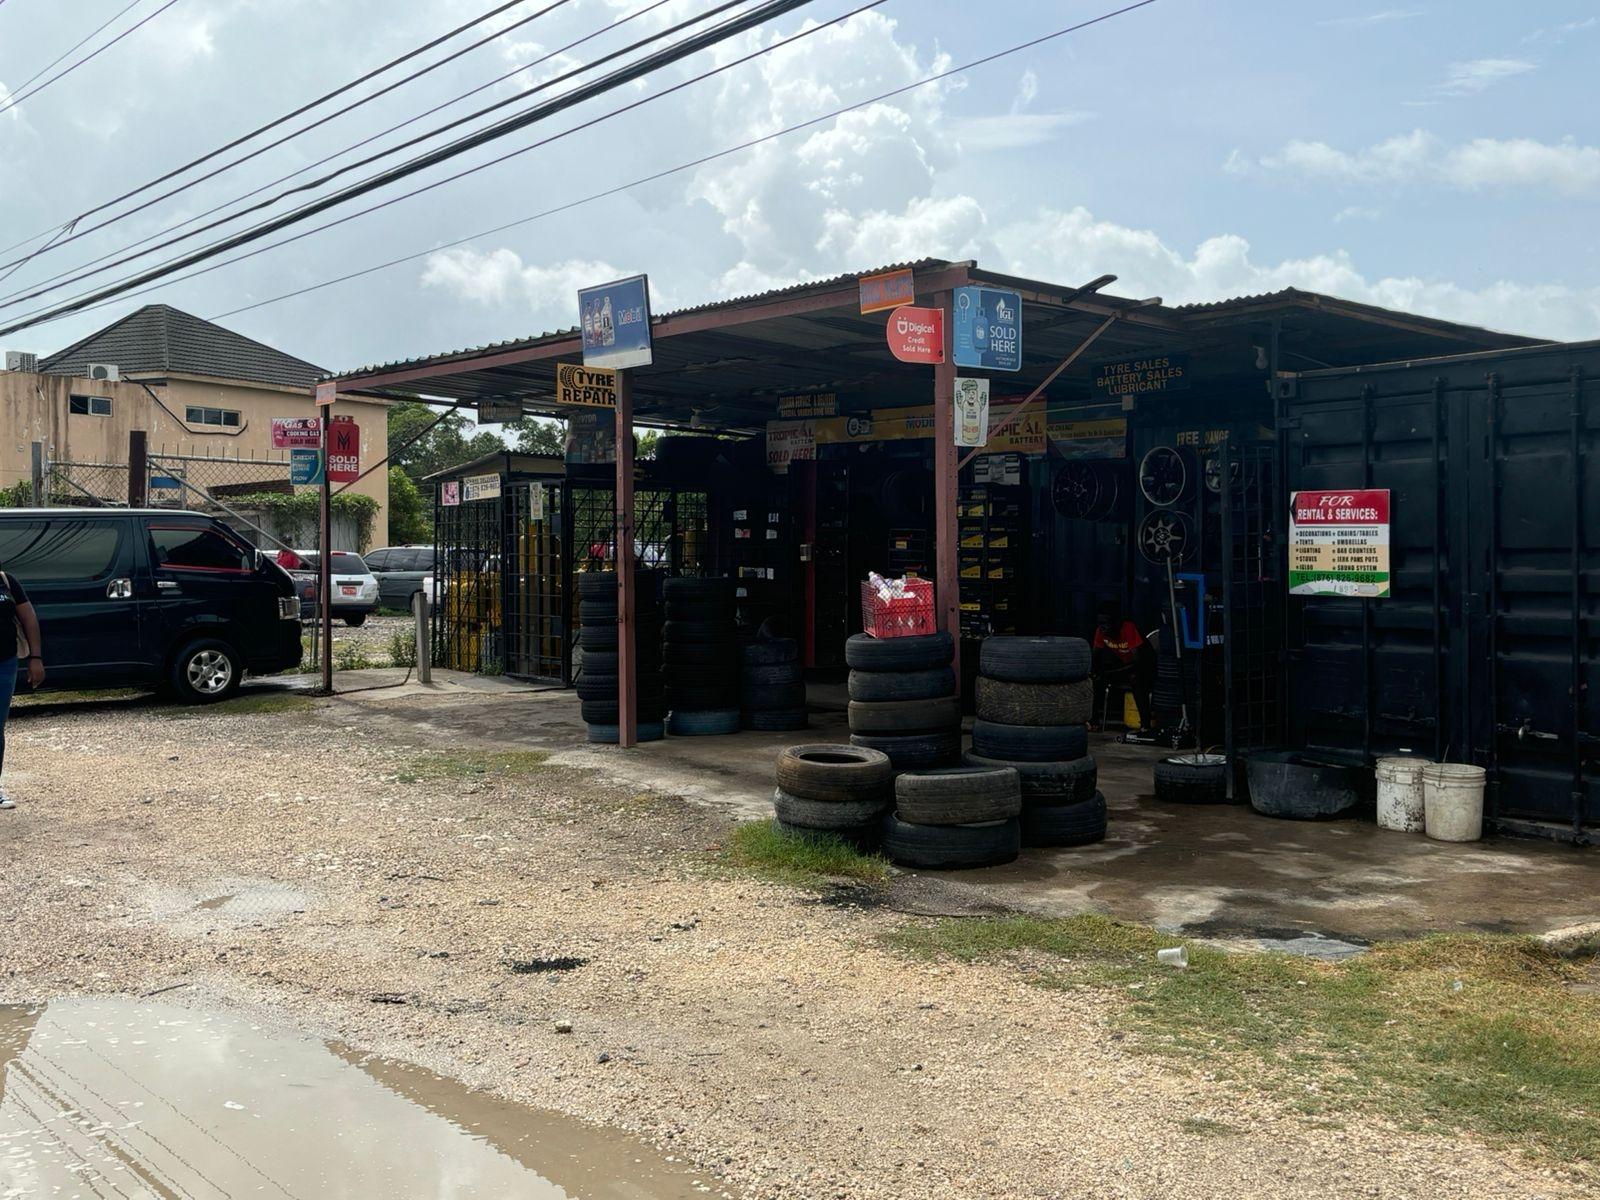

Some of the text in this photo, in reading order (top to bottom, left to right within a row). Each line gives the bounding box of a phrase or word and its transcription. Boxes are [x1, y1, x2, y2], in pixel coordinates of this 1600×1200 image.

[908, 323, 935, 335] Digicel
[990, 325, 1017, 340] SOLD
[908, 336, 925, 344] Credit
[991, 340, 1016, 354] HERE
[1104, 357, 1169, 376] TYRE SALES
[577, 371, 615, 387] TYRE
[1096, 366, 1183, 387] BATTERY SALES
[1108, 378, 1168, 396] LUBRICANT
[562, 388, 616, 405] REPAIR
[768, 428, 815, 441] TROPICAL
[1009, 435, 1043, 445] BATTERY
[329, 455, 358, 464] SOLD
[768, 448, 815, 464] SOLD HERE
[329, 464, 358, 472] HERE
[1319, 495, 1354, 506] FOR
[1297, 508, 1378, 520] RENTAL & SERVICES:
